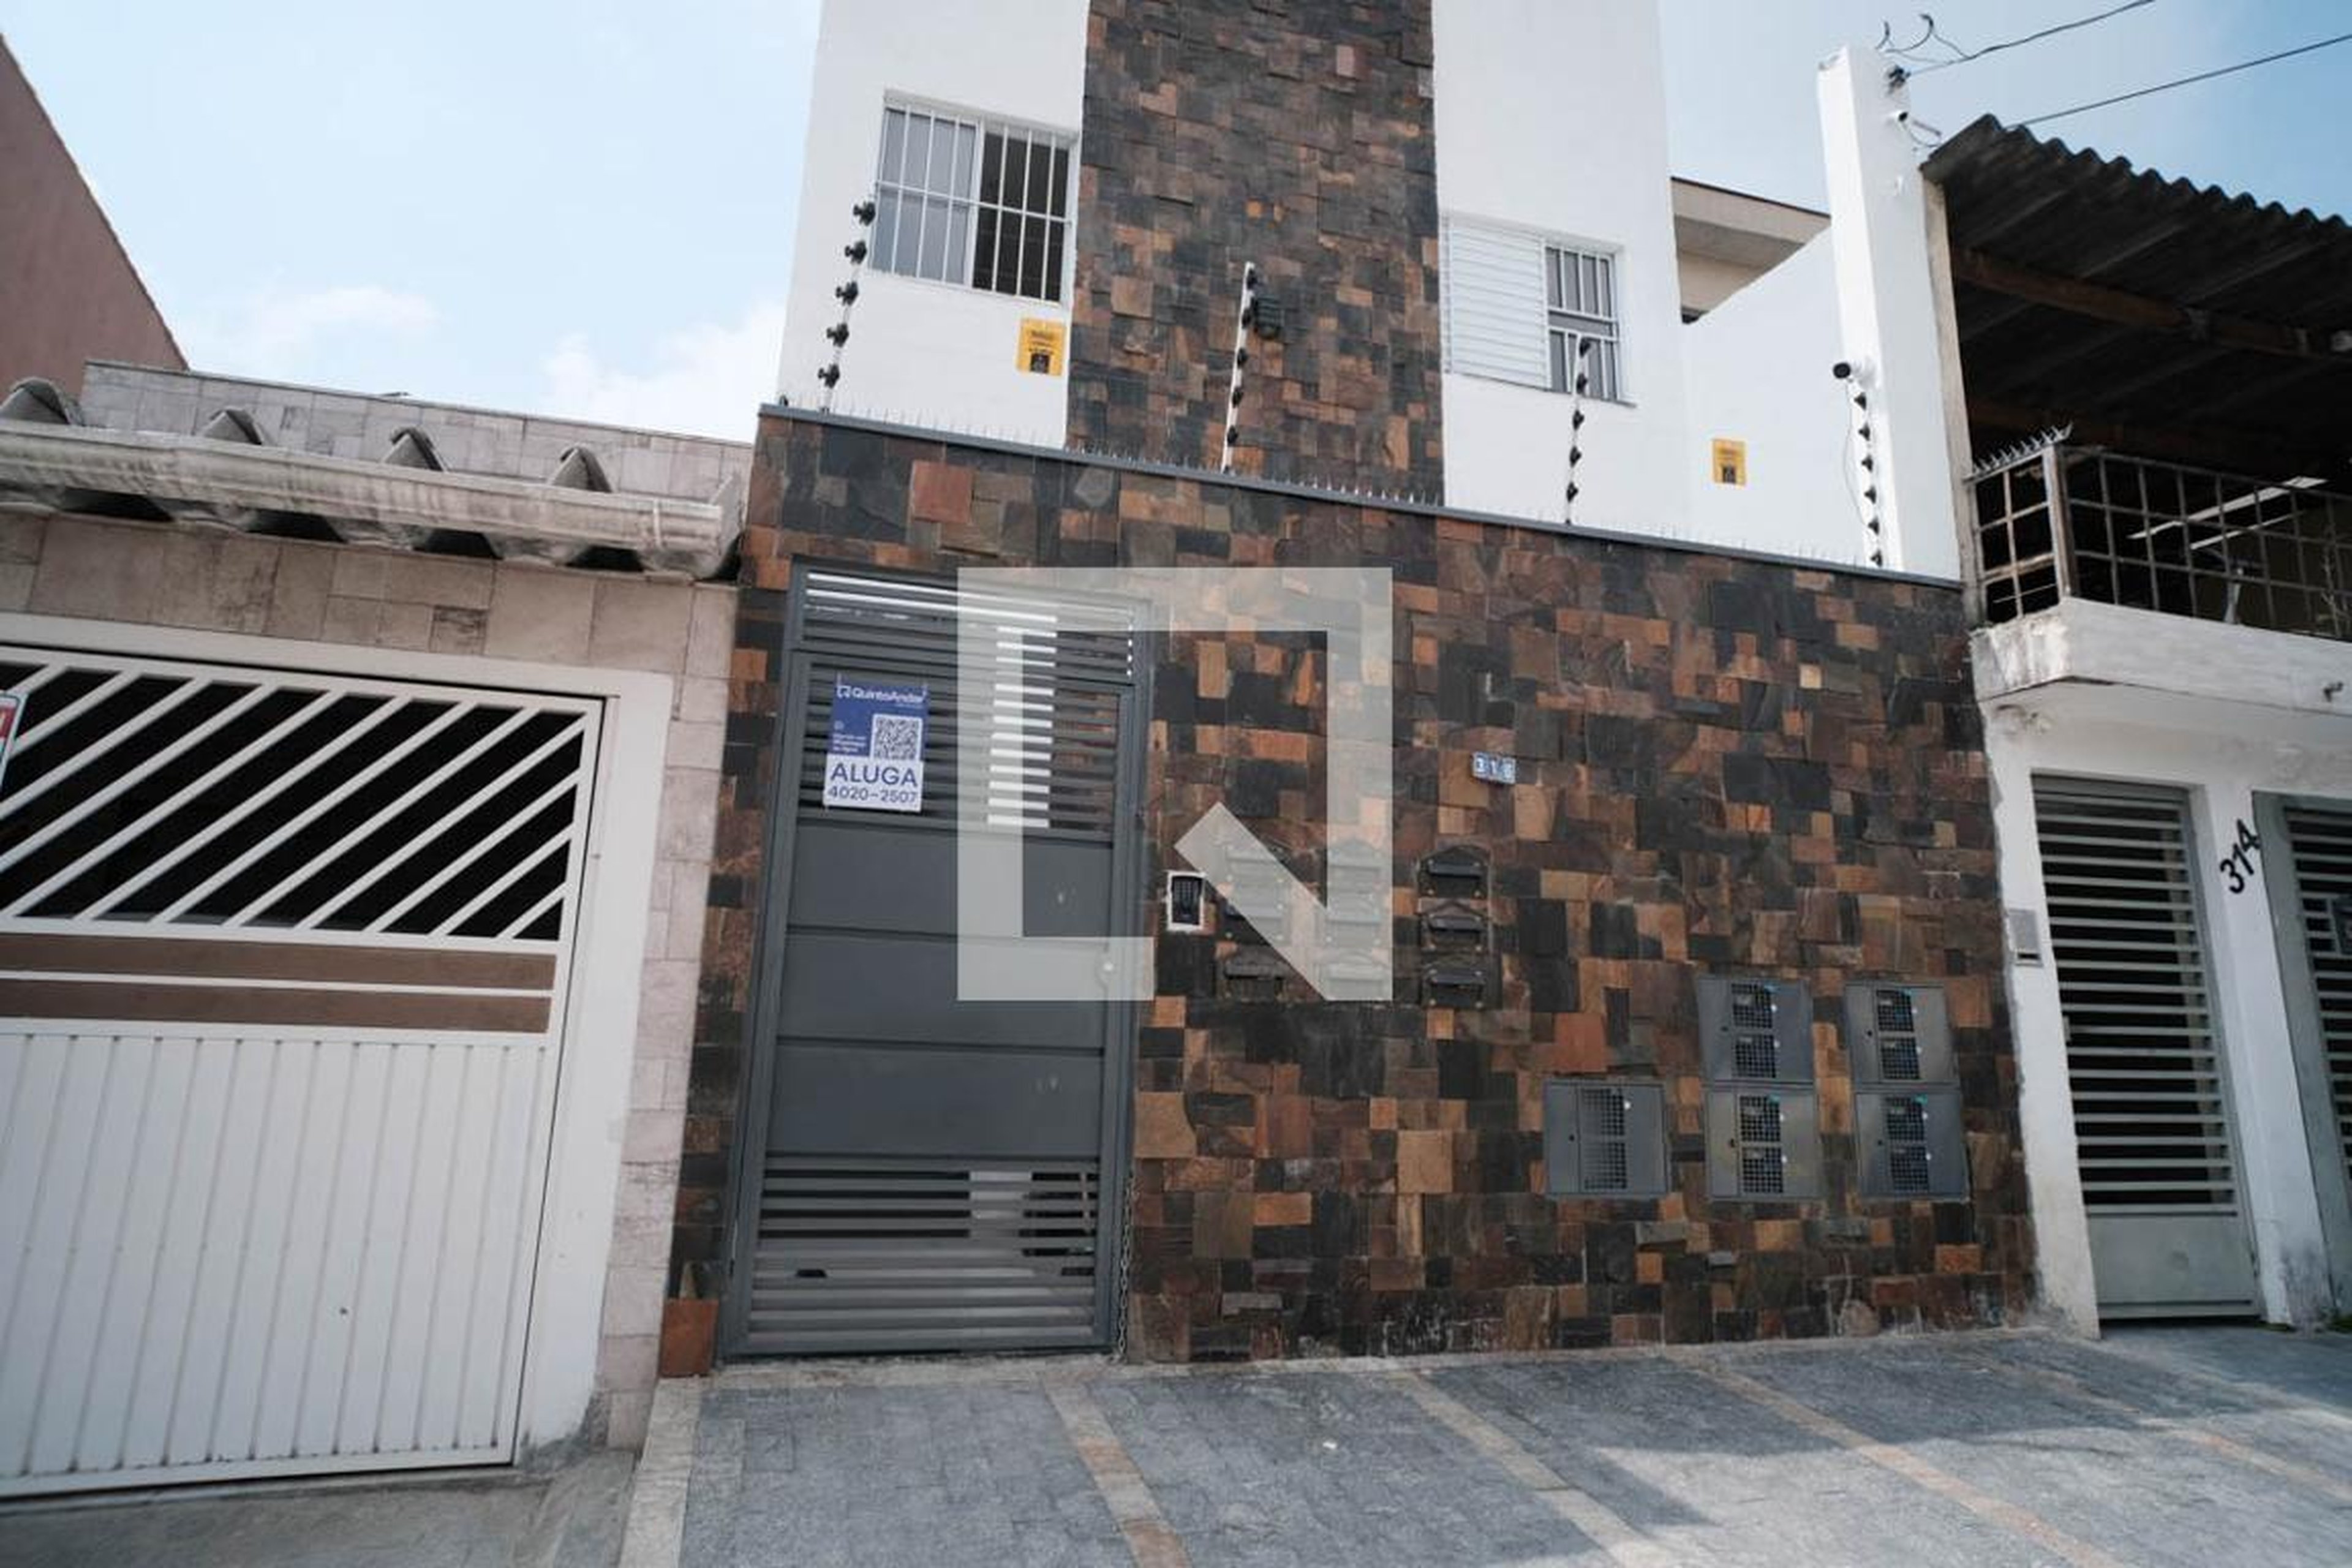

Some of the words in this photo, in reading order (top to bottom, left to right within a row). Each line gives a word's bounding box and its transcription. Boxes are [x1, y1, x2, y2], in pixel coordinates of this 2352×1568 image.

[830, 763, 918, 787] ALUGA
[827, 785, 918, 804] 4020-2507
[2220, 818, 2261, 894] 314
